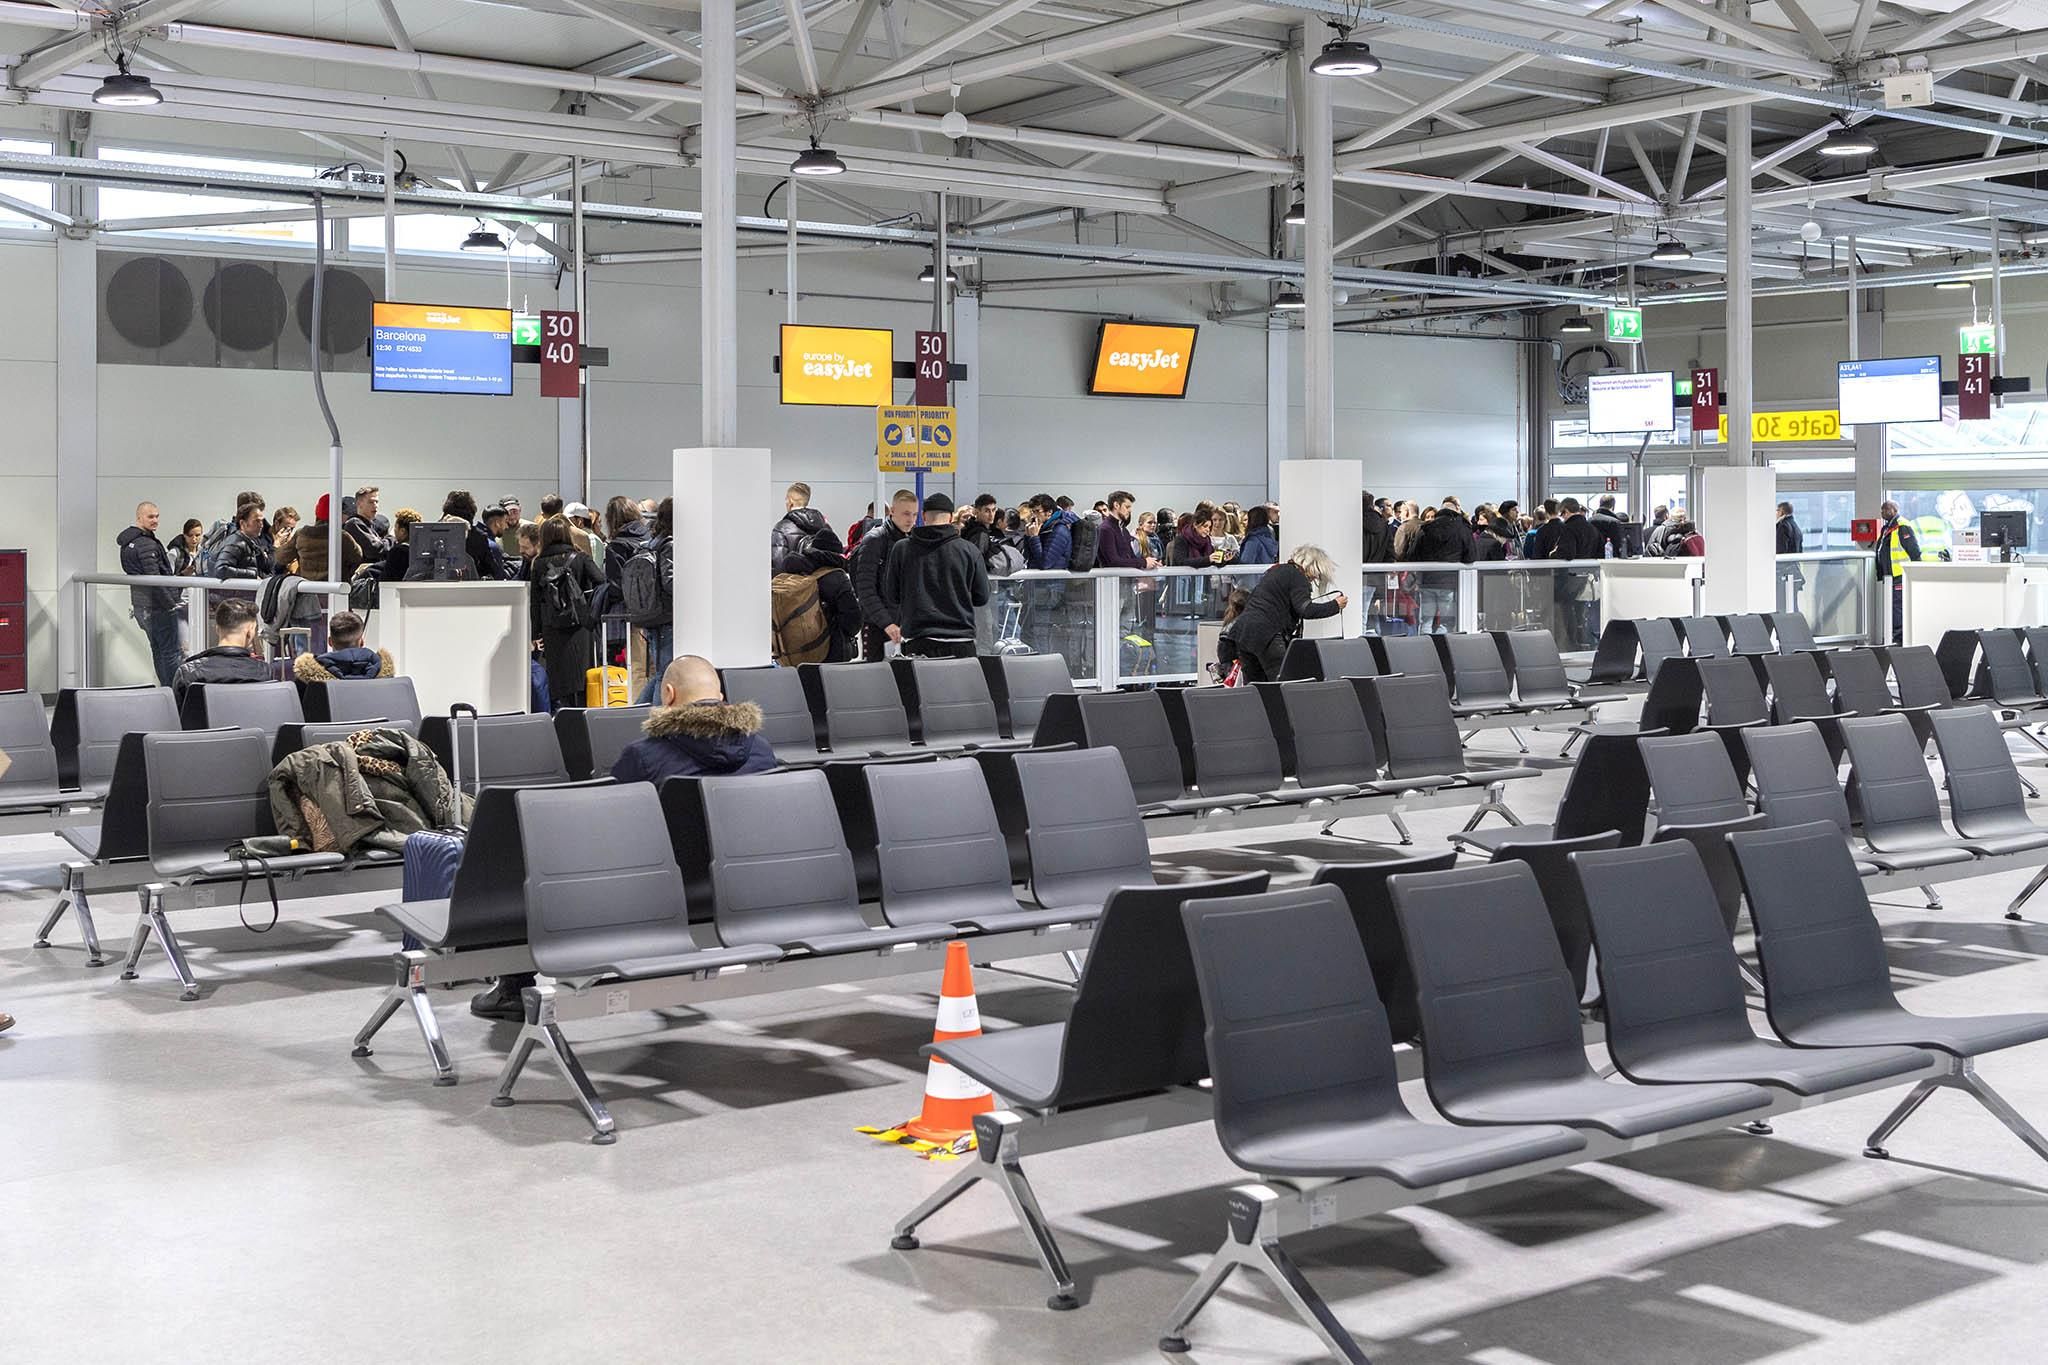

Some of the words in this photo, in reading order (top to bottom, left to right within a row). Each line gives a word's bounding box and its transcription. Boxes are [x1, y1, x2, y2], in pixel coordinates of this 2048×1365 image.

[547, 315, 573, 337] 30
[375, 329, 427, 343] Barcelona
[546, 342, 574, 364] 40
[920, 336, 942, 355] 30
[803, 353, 832, 363] europe
[833, 353, 845, 364] by
[1108, 348, 1180, 371] easyJet
[1965, 356, 1982, 374] 31
[803, 360, 873, 380] easyJet
[920, 360, 943, 379] 40
[1696, 372, 1712, 388] 31
[1964, 377, 1983, 394] 41
[1696, 391, 1713, 407] 41
[895, 410, 916, 419] PRIORITY
[920, 411, 950, 419] PRIORITY
